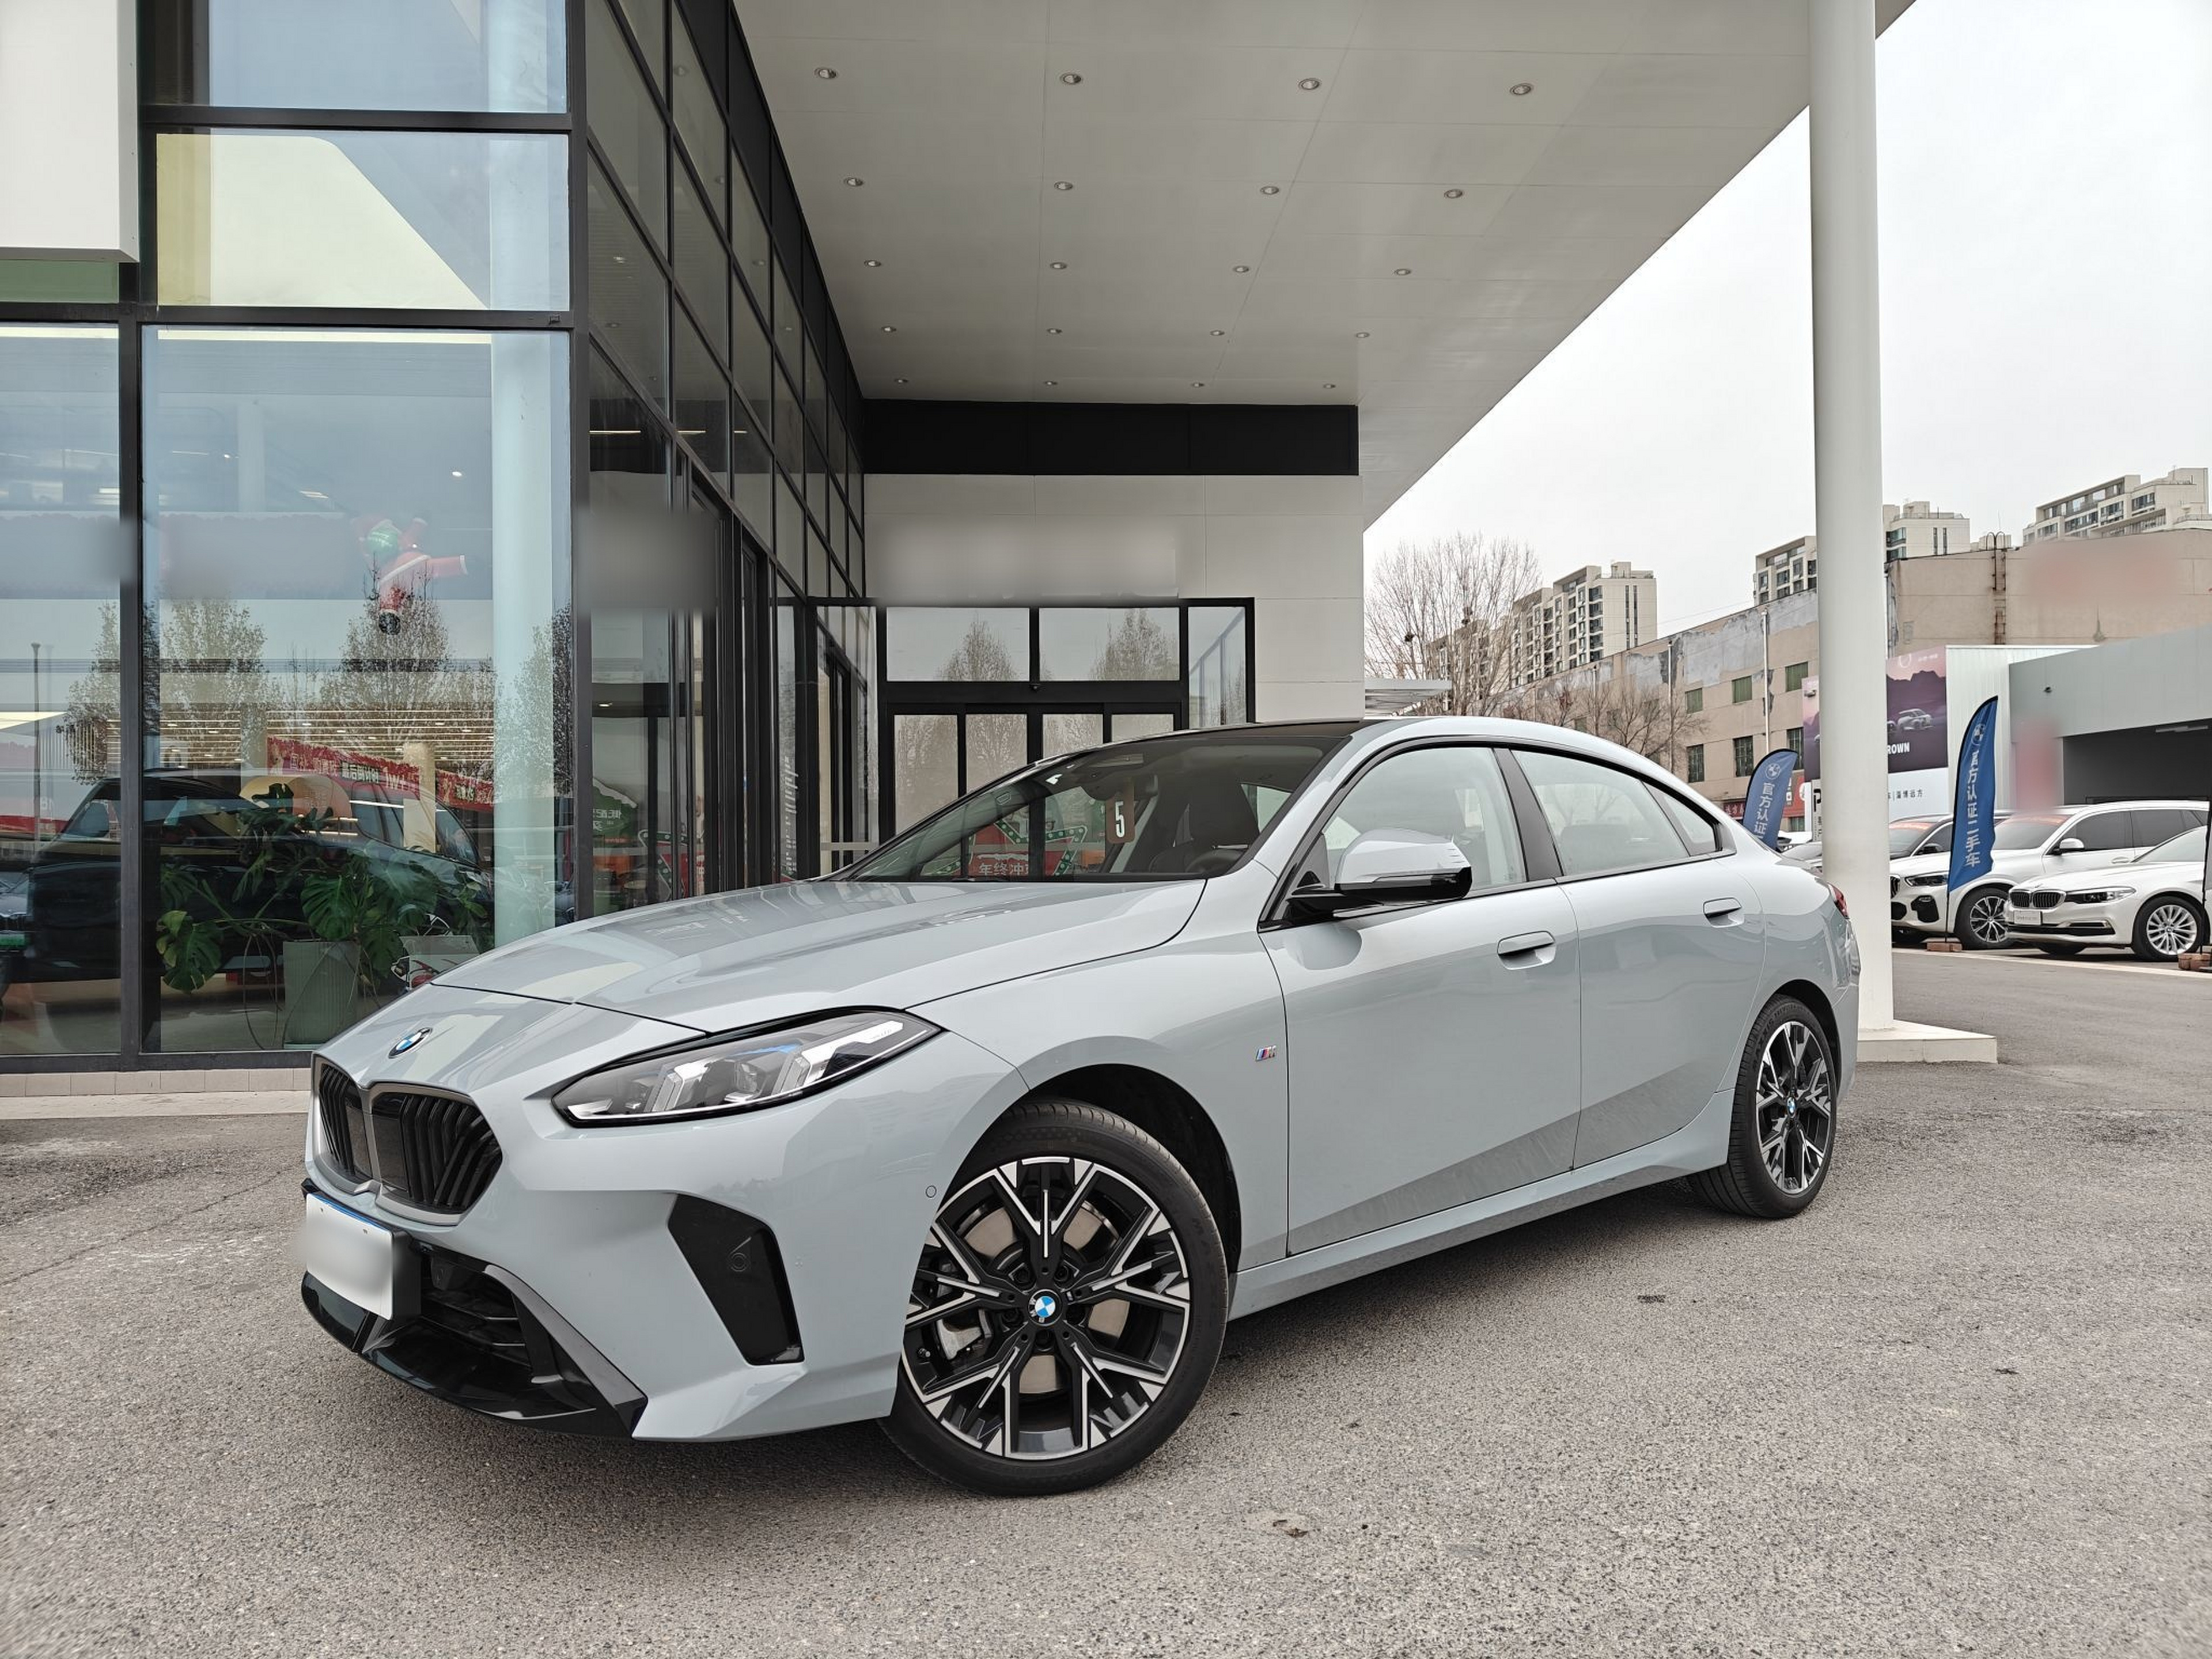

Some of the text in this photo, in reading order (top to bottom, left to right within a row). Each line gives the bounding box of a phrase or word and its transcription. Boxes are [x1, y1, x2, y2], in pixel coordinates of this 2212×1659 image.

[1115, 801, 1125, 838] 5
[1965, 749, 1981, 868] 官方认证二手车
